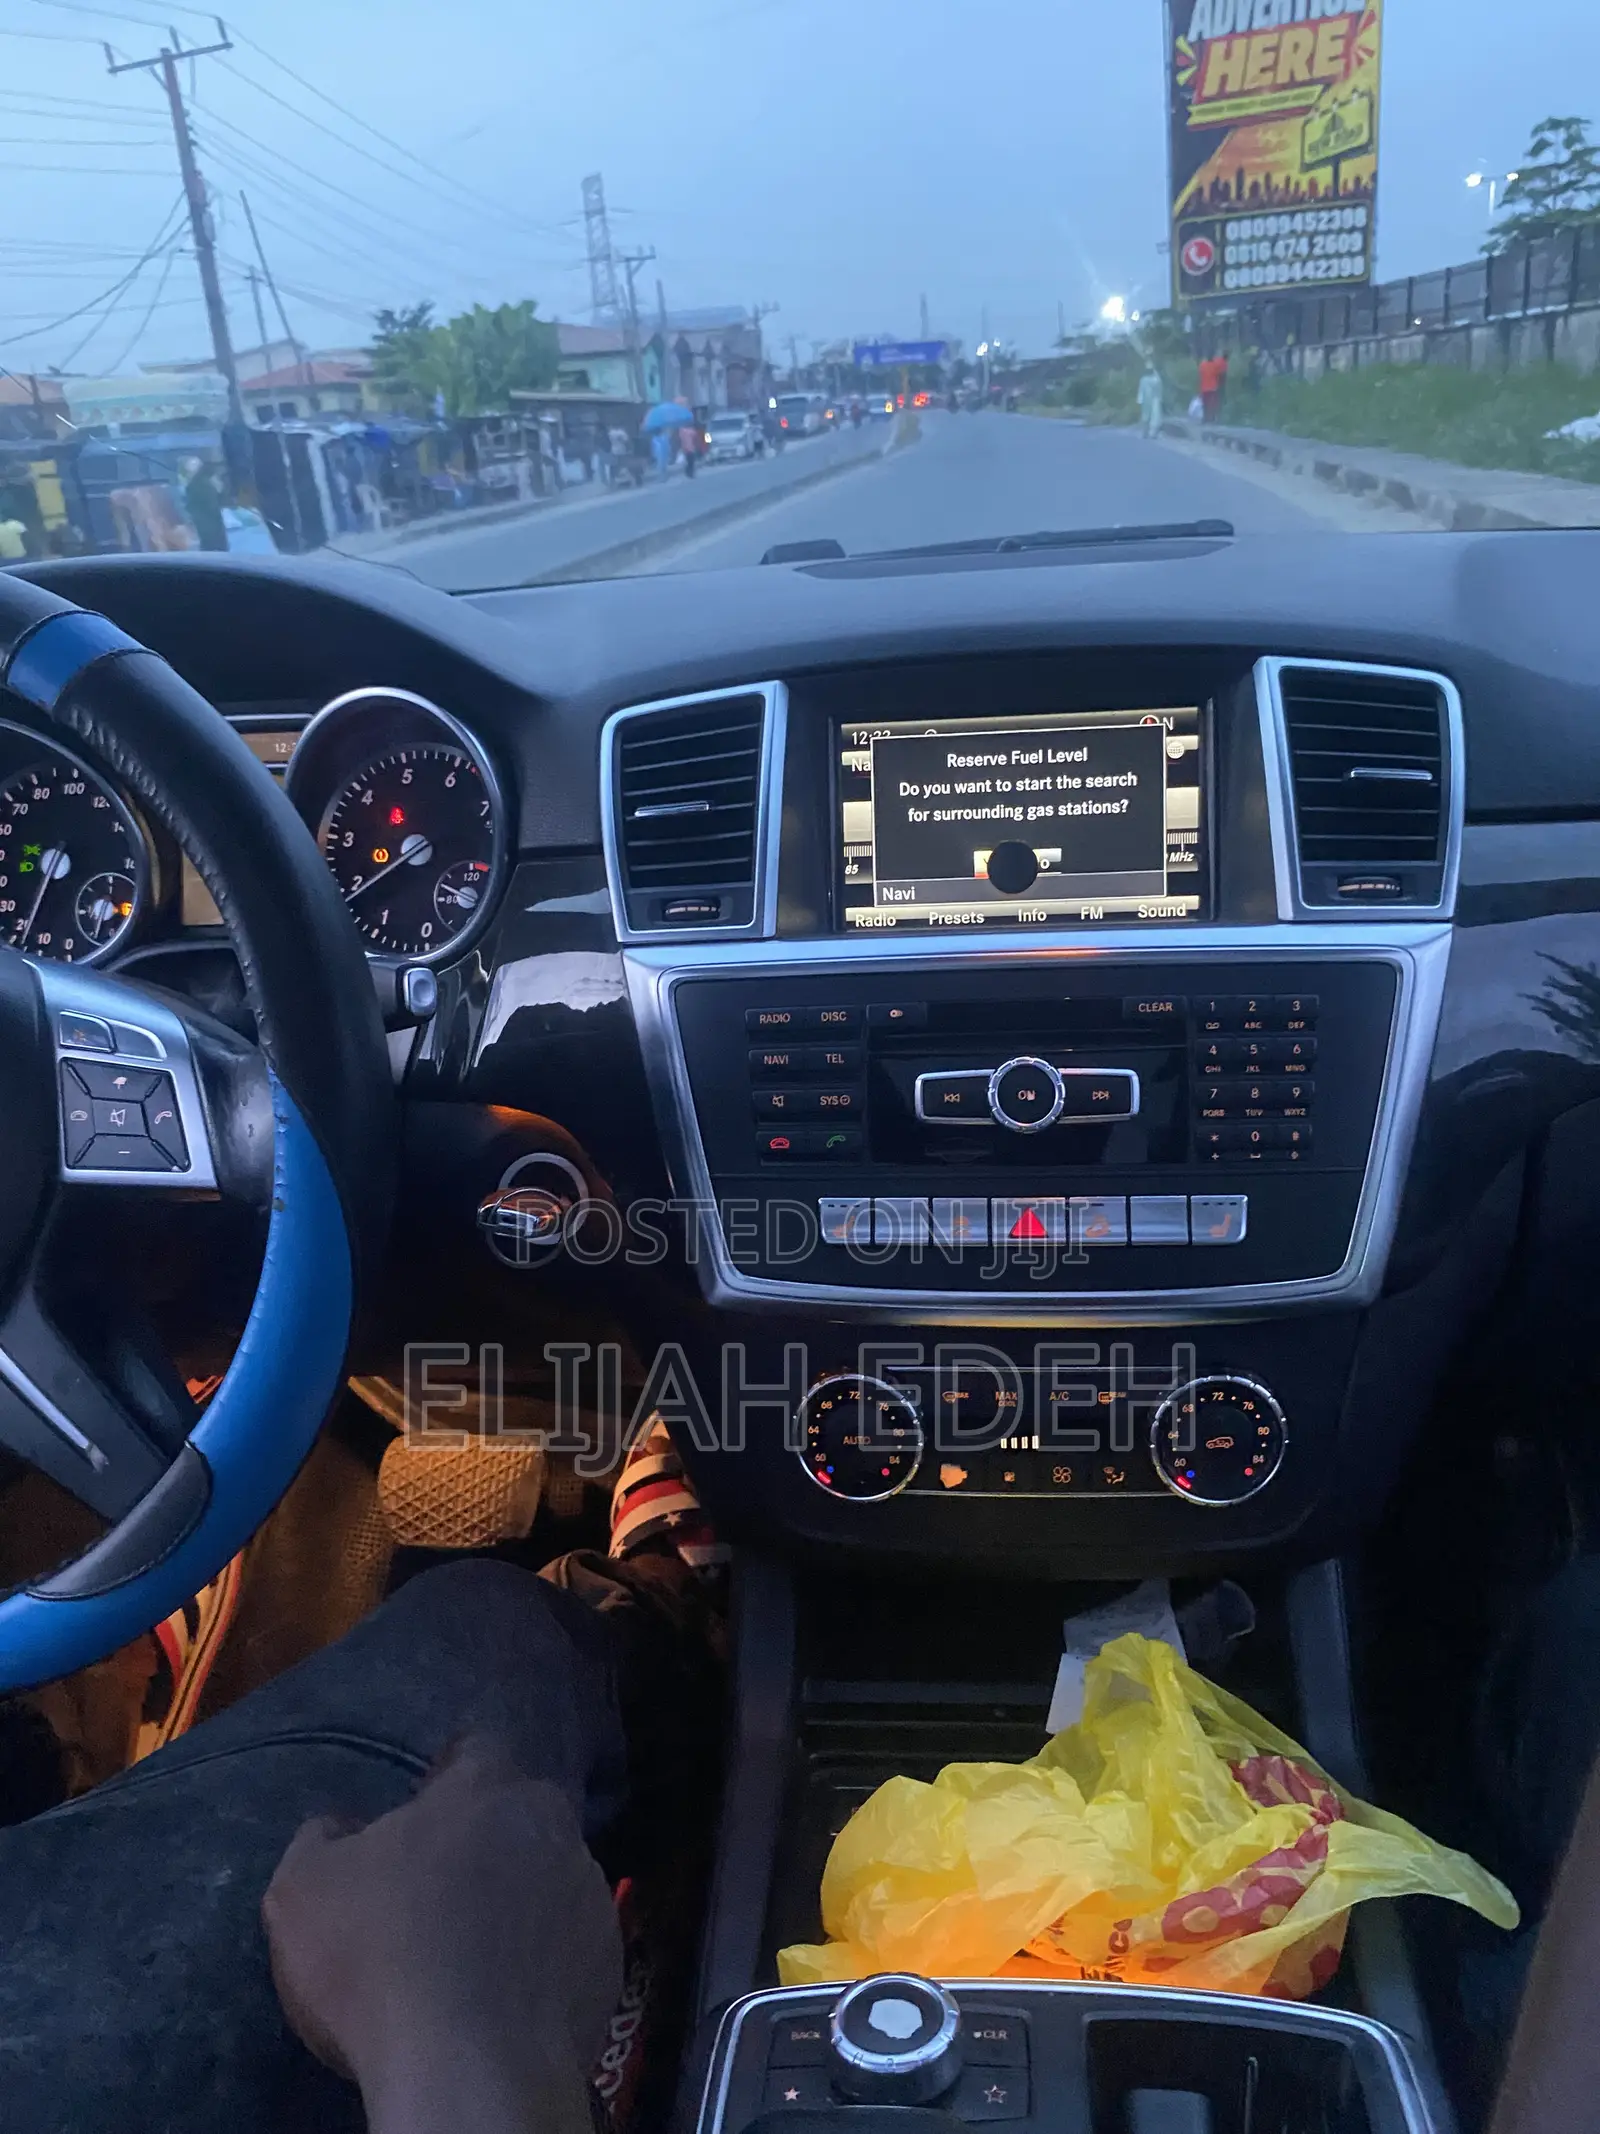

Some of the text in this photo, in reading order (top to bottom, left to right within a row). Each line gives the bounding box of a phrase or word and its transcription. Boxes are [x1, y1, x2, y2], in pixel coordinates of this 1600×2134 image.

[1203, 18, 1349, 97] HERE
[947, 747, 1088, 768] Reserve Fuel Level
[402, 768, 413, 784] 5
[445, 772, 456, 787] 6
[63, 783, 85, 795] 100
[899, 772, 1138, 799] Do you want to start the search
[33, 787, 50, 800] 80
[361, 789, 373, 805] 4
[12, 803, 28, 815] 70
[480, 801, 490, 816] 7
[908, 799, 1129, 822] for surrounding gas stations?
[342, 832, 354, 847] 3
[1169, 852, 1194, 862] MHz
[845, 865, 859, 875] 85
[463, 872, 480, 881] 120
[351, 876, 363, 891] 2
[883, 886, 915, 900] Navi
[1018, 908, 1047, 921] Info
[1081, 906, 1103, 919] FM
[1138, 903, 1187, 918] Sound
[382, 909, 389, 925] 1
[855, 914, 896, 929] Radio
[929, 910, 985, 925] Presets
[421, 922, 432, 937] 0
[38, 933, 51, 945] 10
[65, 938, 74, 950] 0
[1138, 1003, 1173, 1012] CLEAR
[1210, 1001, 1215, 1011] 1
[1249, 1001, 1256, 1011] 2
[1292, 1001, 1301, 1011] 3
[759, 1013, 791, 1024] RADIO
[821, 1012, 847, 1022] DISC
[1288, 1021, 1305, 1029] DEF
[1209, 1045, 1217, 1055] 4
[1250, 1044, 1258, 1054] 5
[1293, 1044, 1301, 1054] 6
[764, 1055, 789, 1065] NAVI
[825, 1054, 844, 1064] TEL
[1210, 1088, 1218, 1099] 7
[1251, 1087, 1260, 1098] 8
[1292, 1087, 1300, 1098] 9
[820, 1095, 839, 1106] SYS
[1284, 1108, 1306, 1116] WXYZ
[1251, 1131, 1260, 1142] 0
[849, 1391, 860, 1399] 72
[995, 1391, 1018, 1401] MAX
[1050, 1392, 1070, 1401] A/C
[1212, 1391, 1224, 1400] 72
[821, 1401, 833, 1409] 68
[879, 1402, 889, 1411] 76
[1243, 1401, 1254, 1410] 76
[808, 1426, 819, 1434] 64
[1258, 1427, 1270, 1435] 80
[843, 1436, 871, 1444] AUTO
[815, 1453, 826, 1461] 60
[889, 1456, 900, 1464] 84
[1253, 1455, 1264, 1463] 84
[1174, 1458, 1186, 1467] 60
